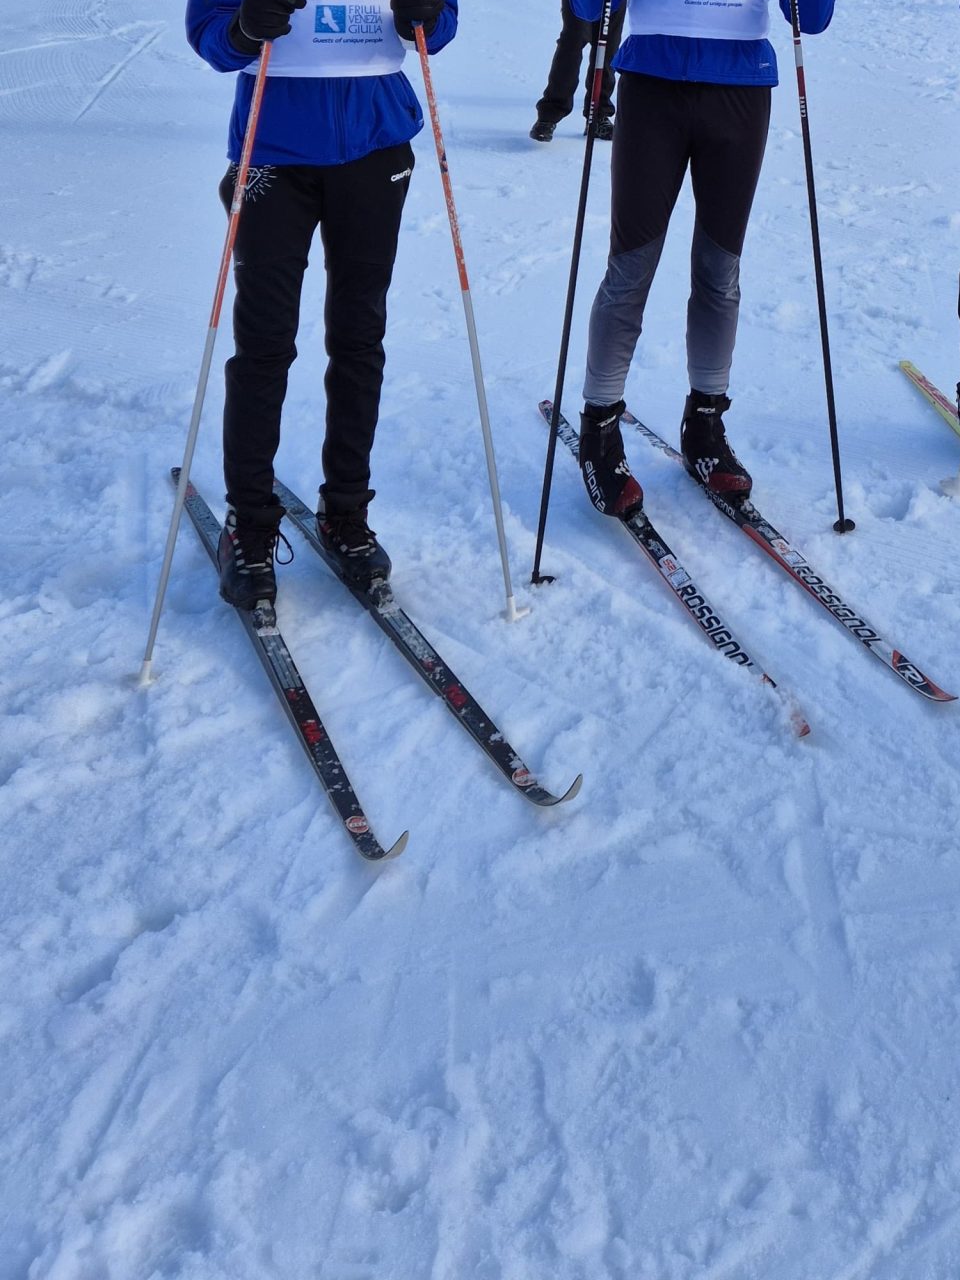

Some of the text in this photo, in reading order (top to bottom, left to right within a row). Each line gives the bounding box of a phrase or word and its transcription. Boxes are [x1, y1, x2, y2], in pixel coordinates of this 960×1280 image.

[348, 5, 381, 14] FRIULI
[348, 15, 382, 24] VENEZIA
[348, 24, 383, 34] GIULIA
[584, 460, 607, 513] alpina
[791, 565, 883, 649] ROSSIGNOL
